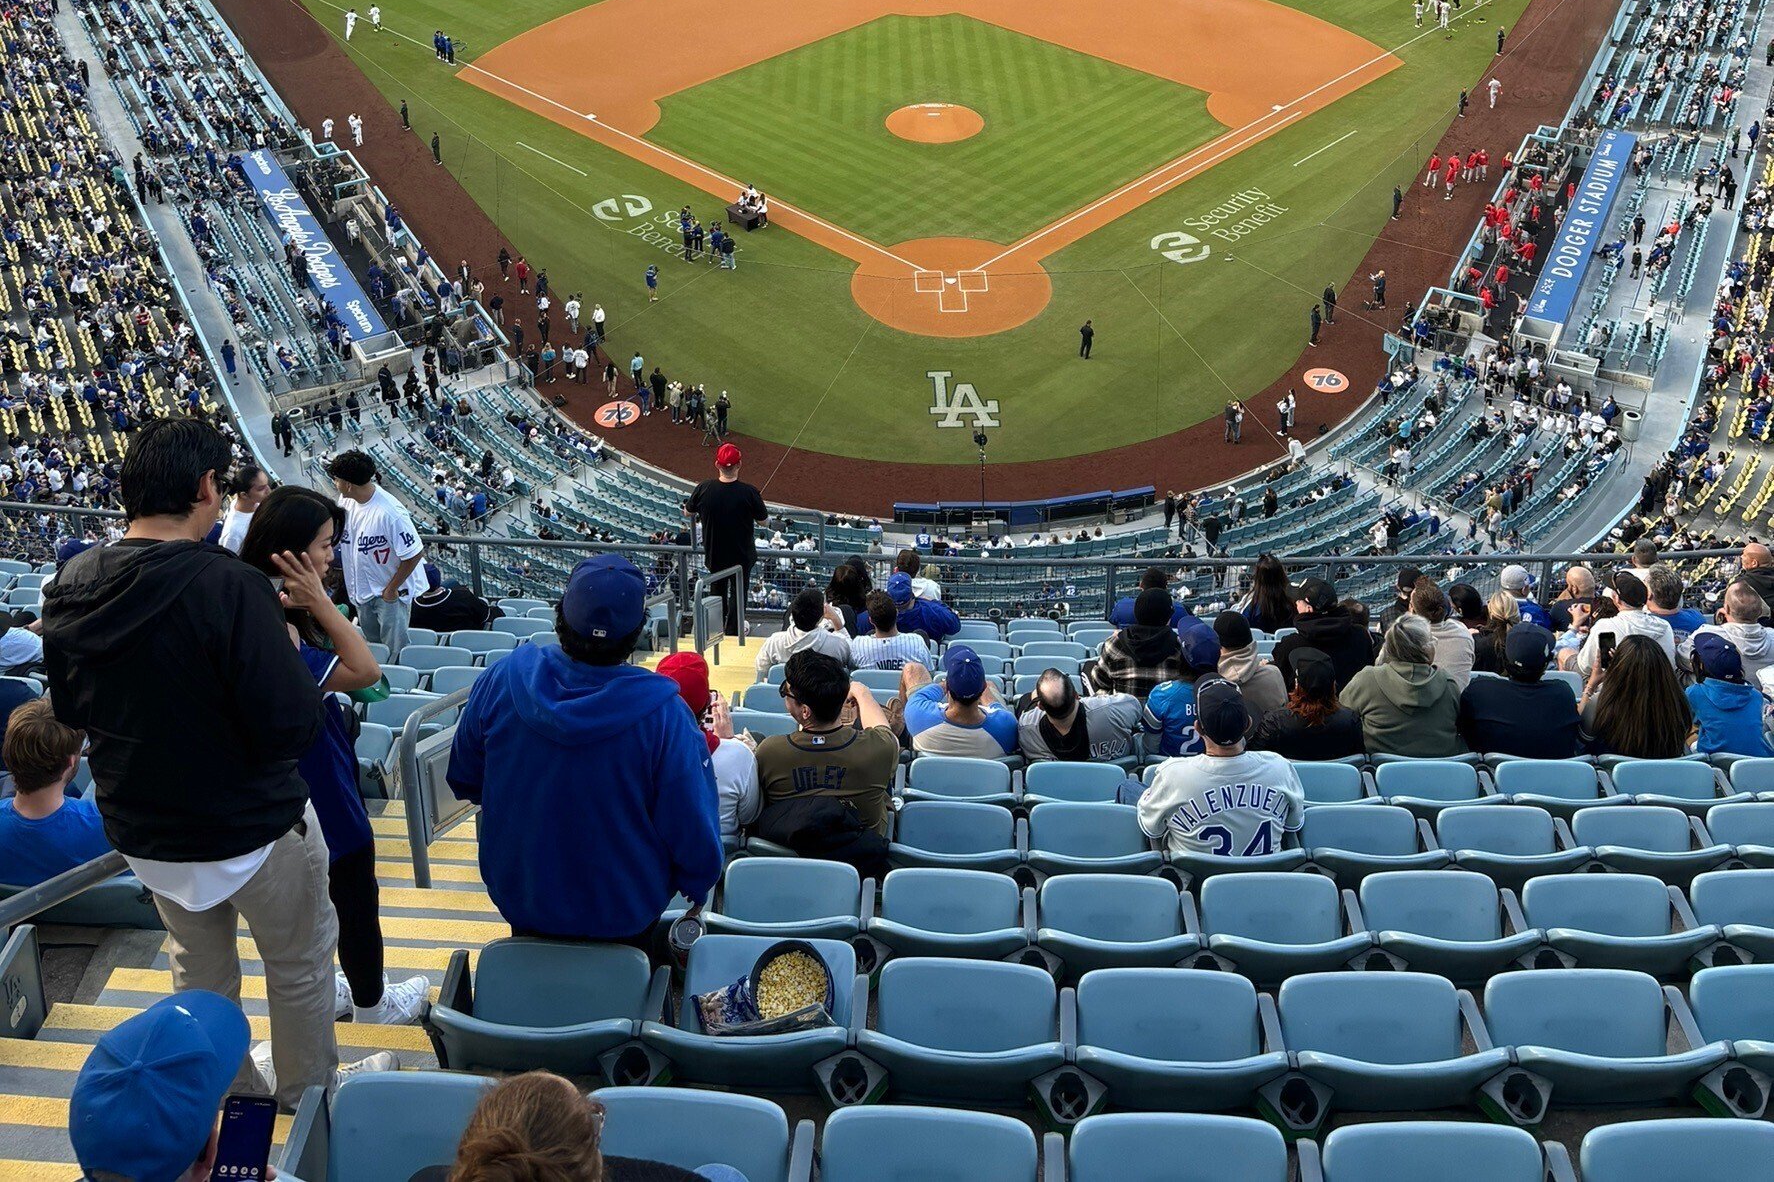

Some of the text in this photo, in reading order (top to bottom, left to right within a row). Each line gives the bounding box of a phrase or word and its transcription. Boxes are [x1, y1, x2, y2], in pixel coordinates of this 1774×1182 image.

[250, 151, 272, 175] Spectrum
[1579, 159, 1618, 215] STADIUM
[1183, 186, 1271, 232] Security
[1210, 203, 1289, 243] Benefit
[262, 188, 341, 288] Los Angeles Dodgers
[628, 222, 706, 265] Benet
[1551, 219, 1591, 279] DODGER
[346, 300, 373, 333] Spectrum
[926, 370, 1001, 428] LA
[1311, 374, 1342, 387] 76
[602, 404, 636, 422] 76
[373, 547, 391, 565] 17
[399, 531, 416, 548] LA
[792, 765, 847, 793] UTLEY
[1171, 783, 1291, 833] VALENZUELA
[1197, 819, 1275, 857] 34
